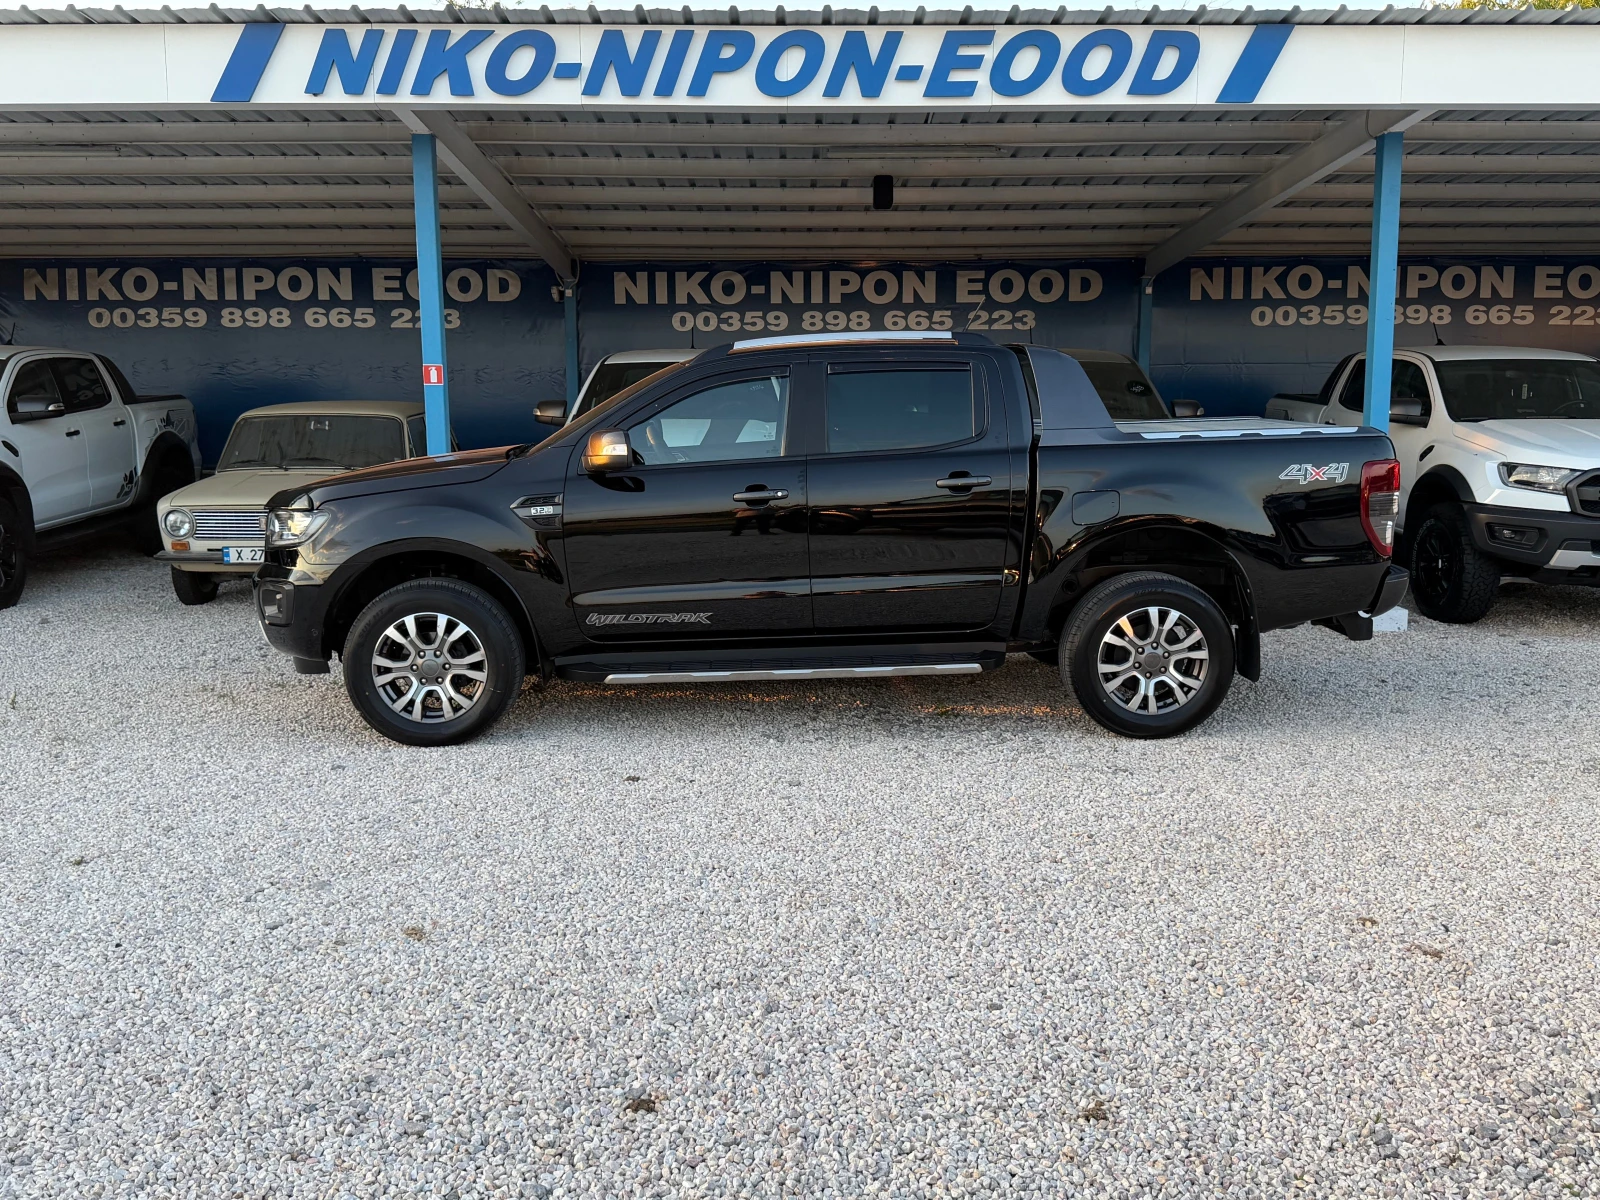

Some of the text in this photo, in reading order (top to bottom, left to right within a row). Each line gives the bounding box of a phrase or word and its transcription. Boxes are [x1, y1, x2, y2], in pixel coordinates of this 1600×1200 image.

[304, 28, 1201, 98] NIKO-NIPON-EOOD
[23, 266, 353, 301] NIKO-NIPON
[613, 268, 1104, 304] NIKO-NIPON EOOD
[87, 307, 461, 329] 00359 898 665 23
[671, 309, 1037, 332] 00359 898 665 223
[1250, 304, 1369, 326] 00359
[1464, 304, 1535, 325] 665
[585, 612, 714, 627] WILDTRAK
